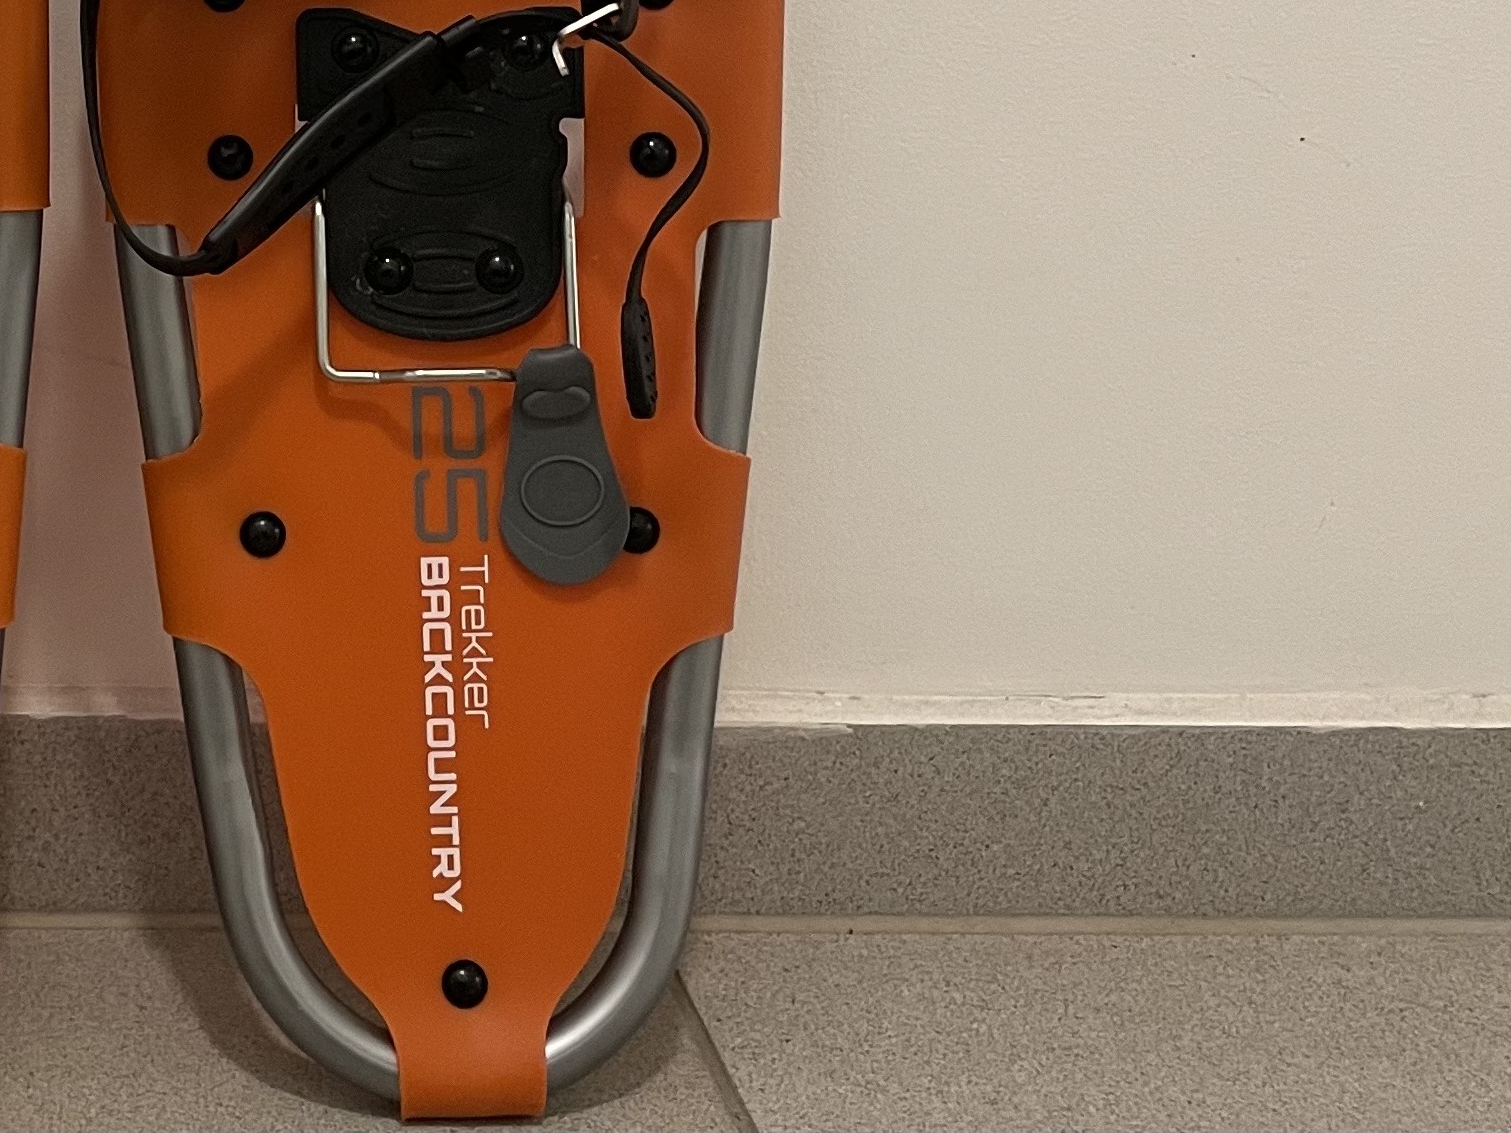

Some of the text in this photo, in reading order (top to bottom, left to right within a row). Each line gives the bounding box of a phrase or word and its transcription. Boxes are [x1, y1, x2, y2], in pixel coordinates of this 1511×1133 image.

[411, 385, 489, 543] 25
[459, 554, 493, 729] Trekker
[420, 556, 463, 912] BACKCOUNTRY
